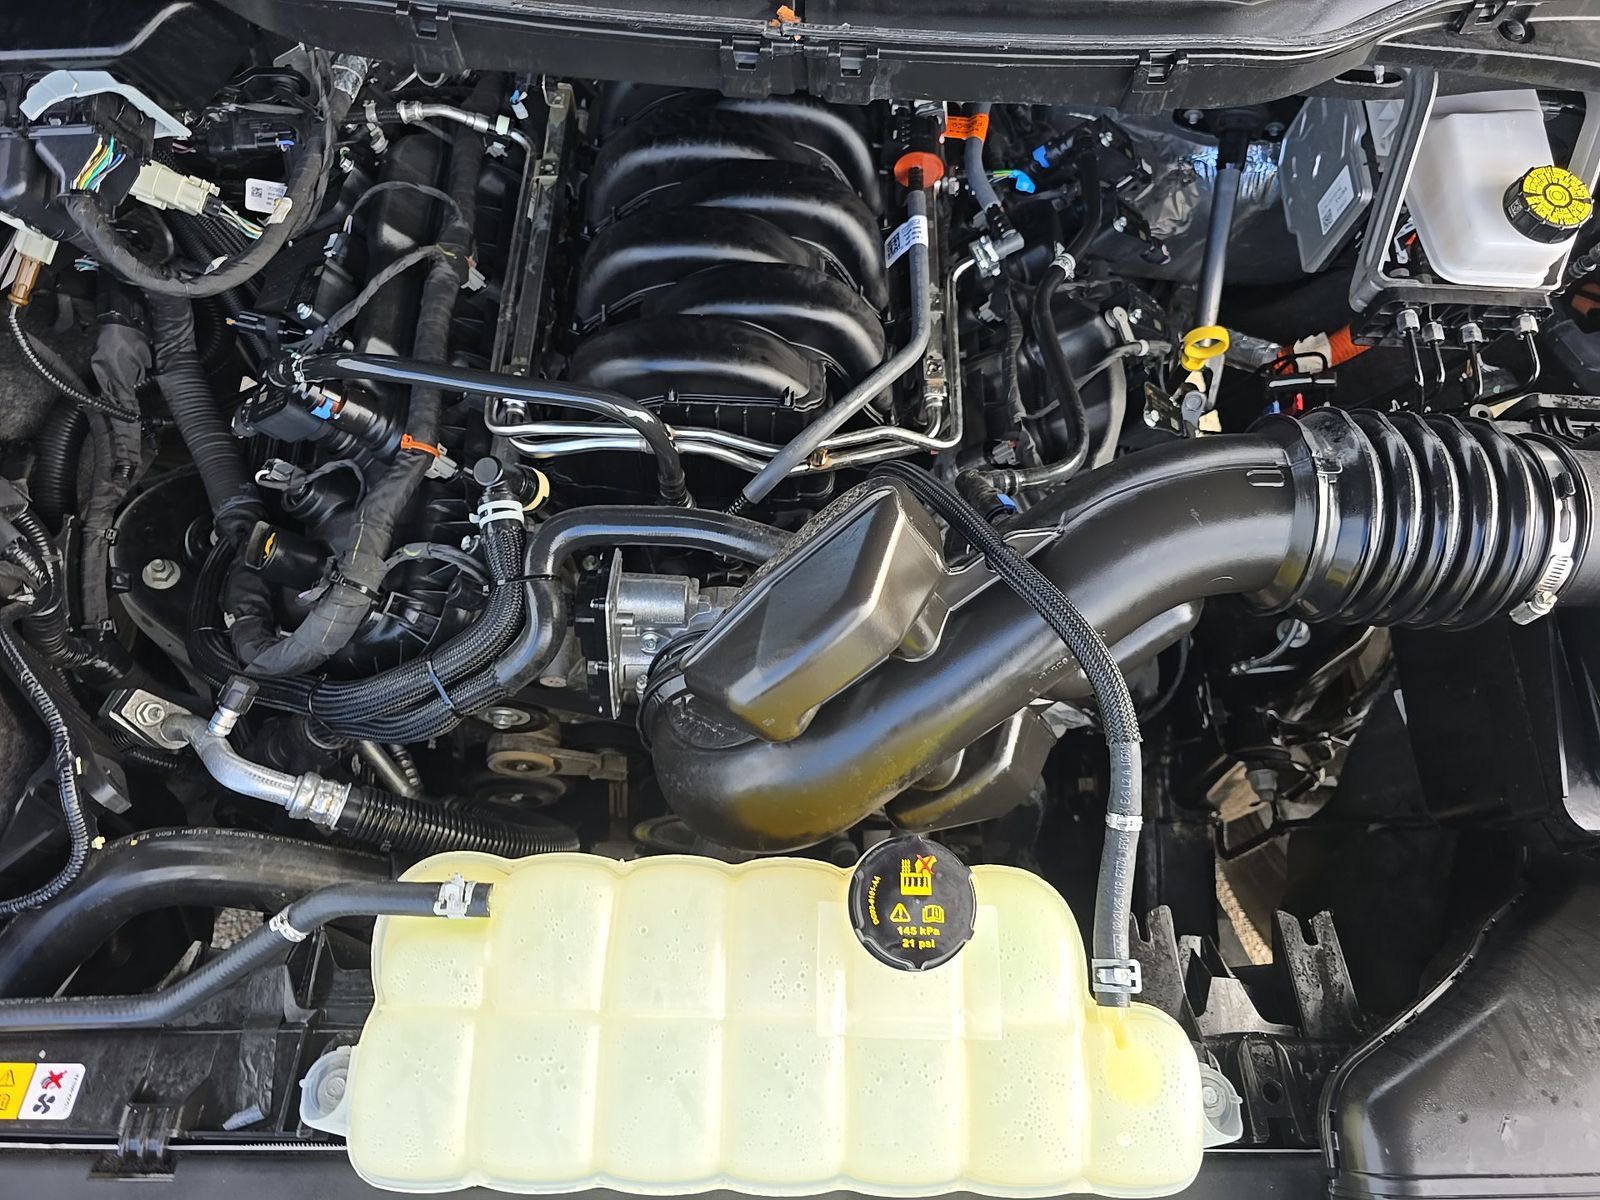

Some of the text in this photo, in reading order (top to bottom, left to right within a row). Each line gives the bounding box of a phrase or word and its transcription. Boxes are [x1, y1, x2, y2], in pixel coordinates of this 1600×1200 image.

[897, 926, 940, 936] 145 kPa
[902, 938, 935, 950] 21 psi
